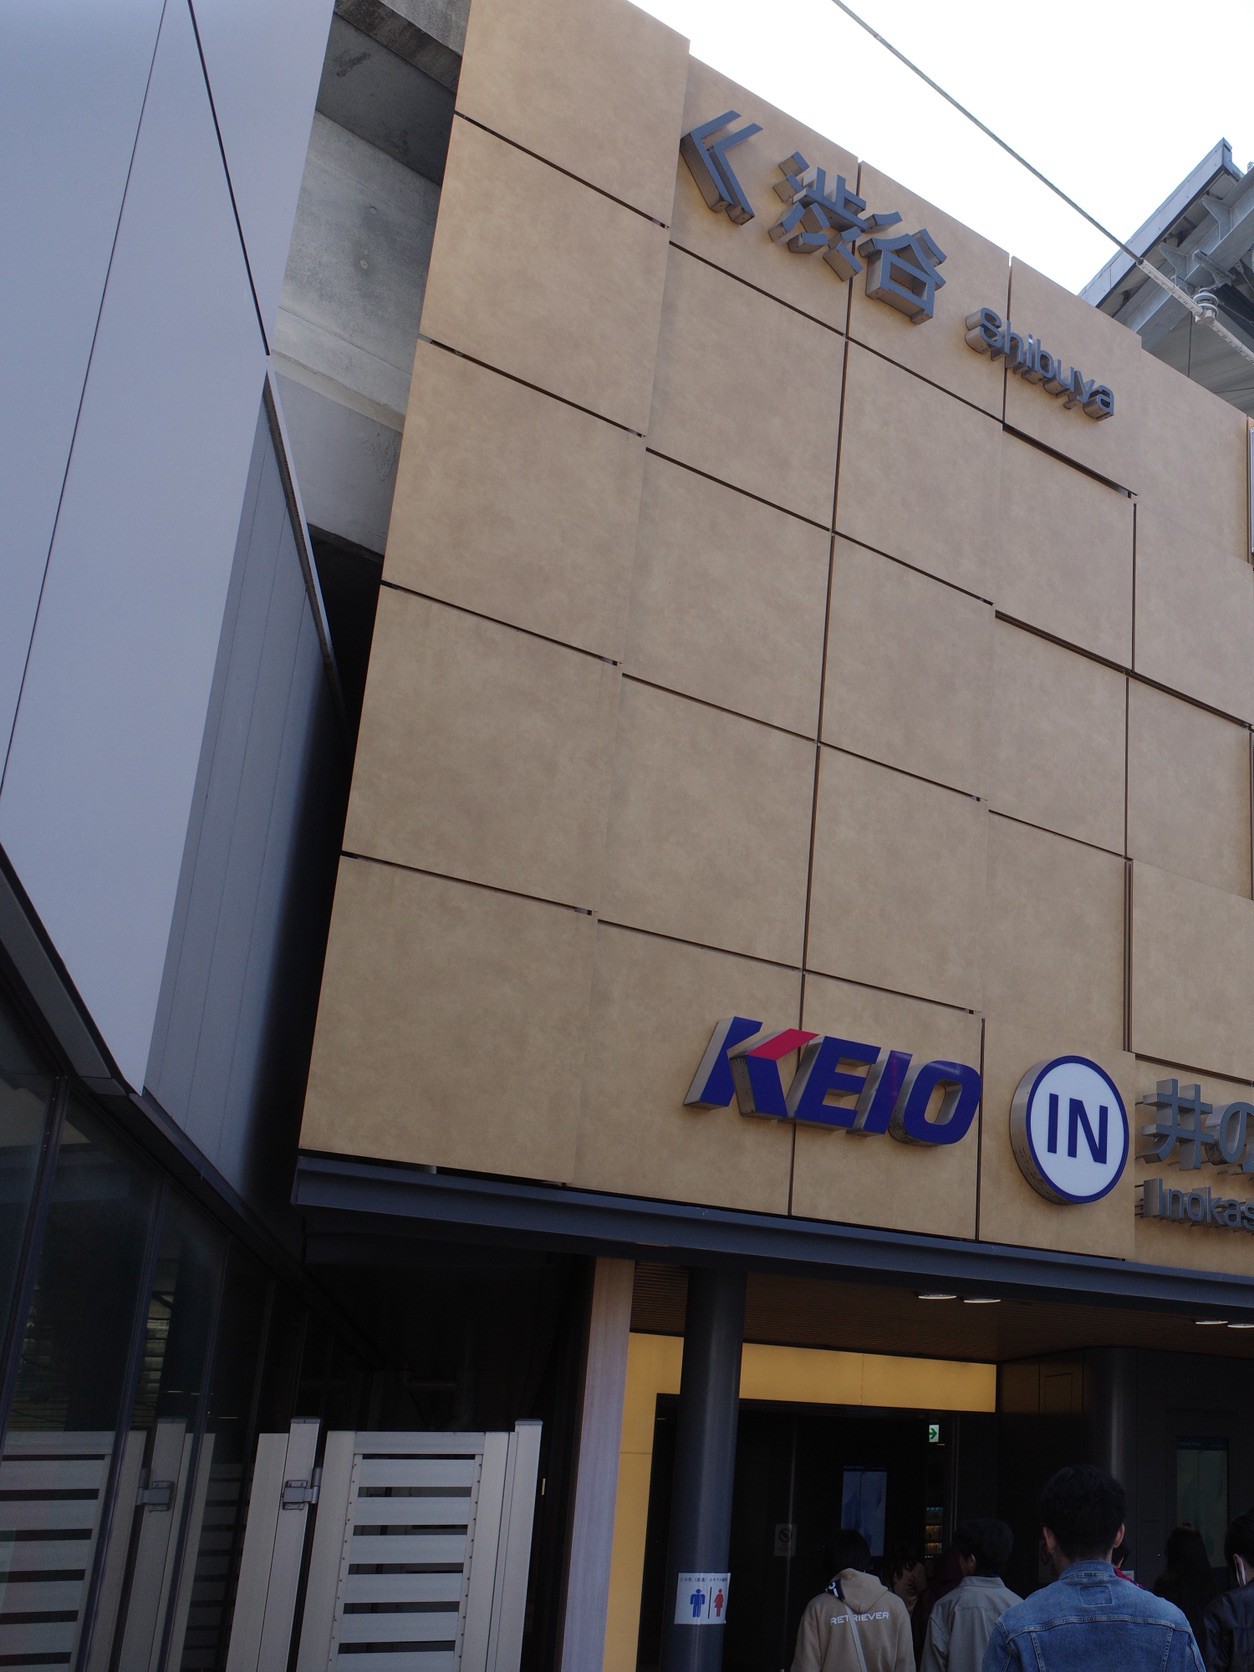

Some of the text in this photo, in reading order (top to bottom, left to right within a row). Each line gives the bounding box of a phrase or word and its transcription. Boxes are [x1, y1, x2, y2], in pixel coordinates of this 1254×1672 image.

[770, 151, 947, 324] 渋谷
[966, 307, 1115, 420] Shibuya
[683, 1016, 983, 1147] KEIO
[1046, 1093, 1109, 1165] IN
[830, 1611, 890, 1626] RETRIEVER
